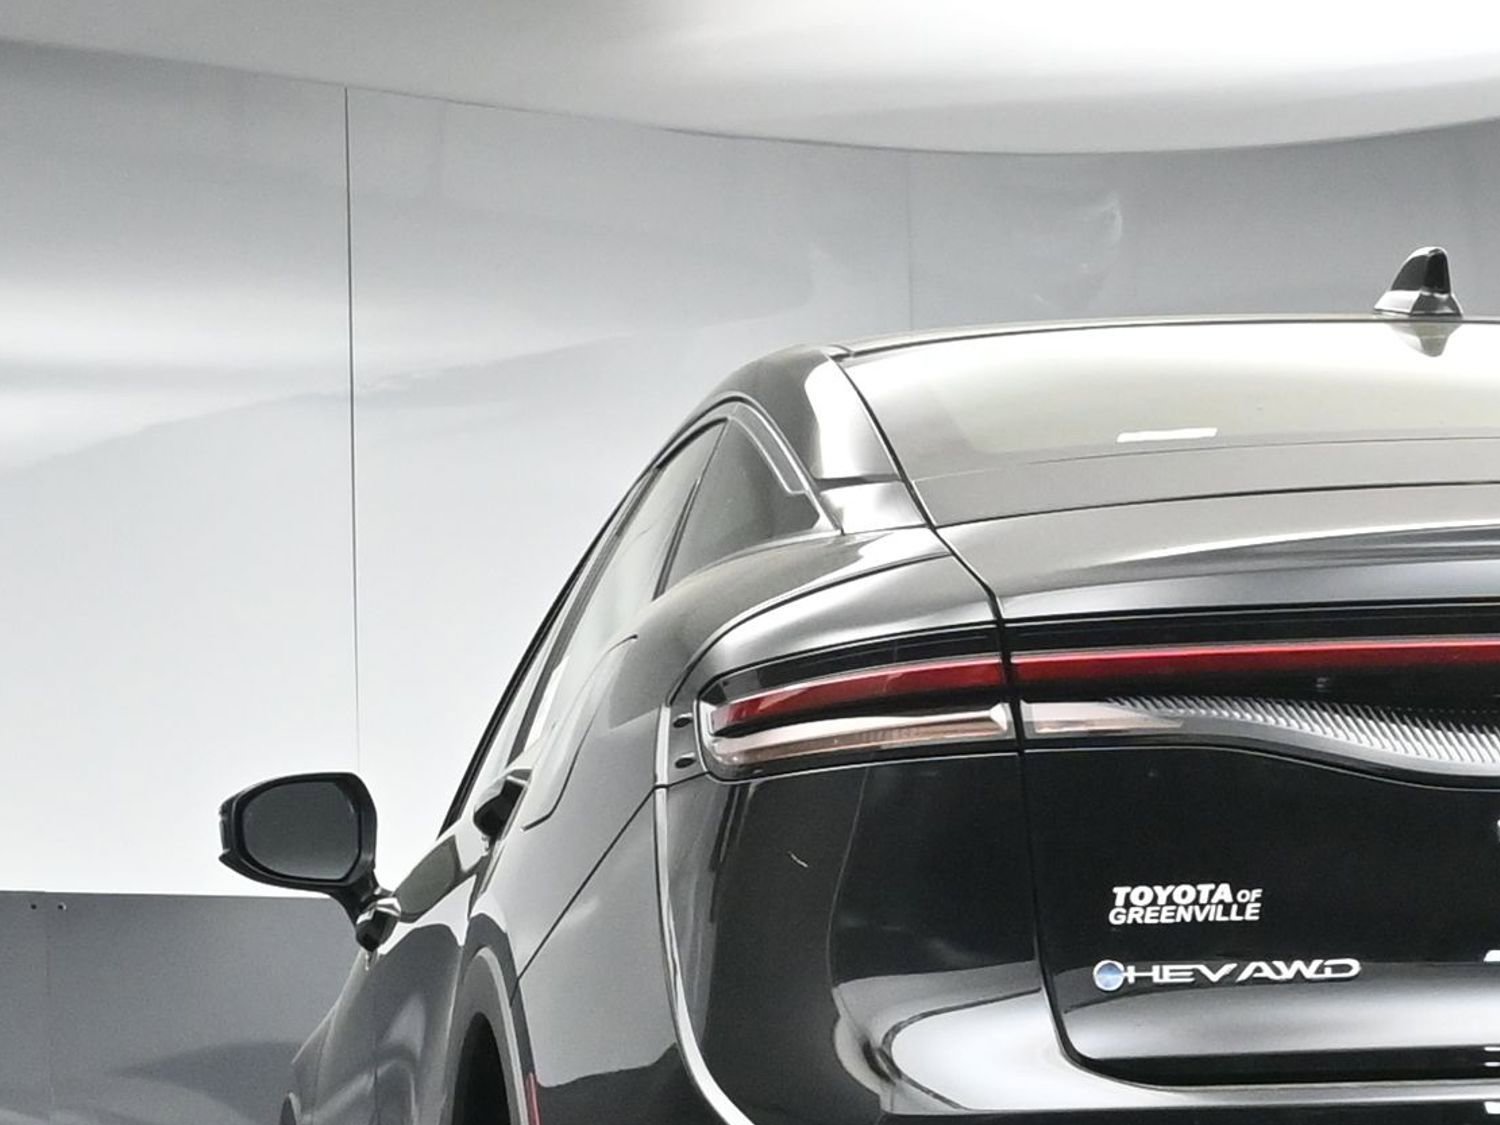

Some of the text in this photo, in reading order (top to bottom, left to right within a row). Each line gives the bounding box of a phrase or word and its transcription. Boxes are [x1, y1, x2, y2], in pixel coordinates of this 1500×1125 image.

[1112, 883, 1264, 907] TOYOTA OF
[1108, 902, 1263, 926] GREENVILLE
